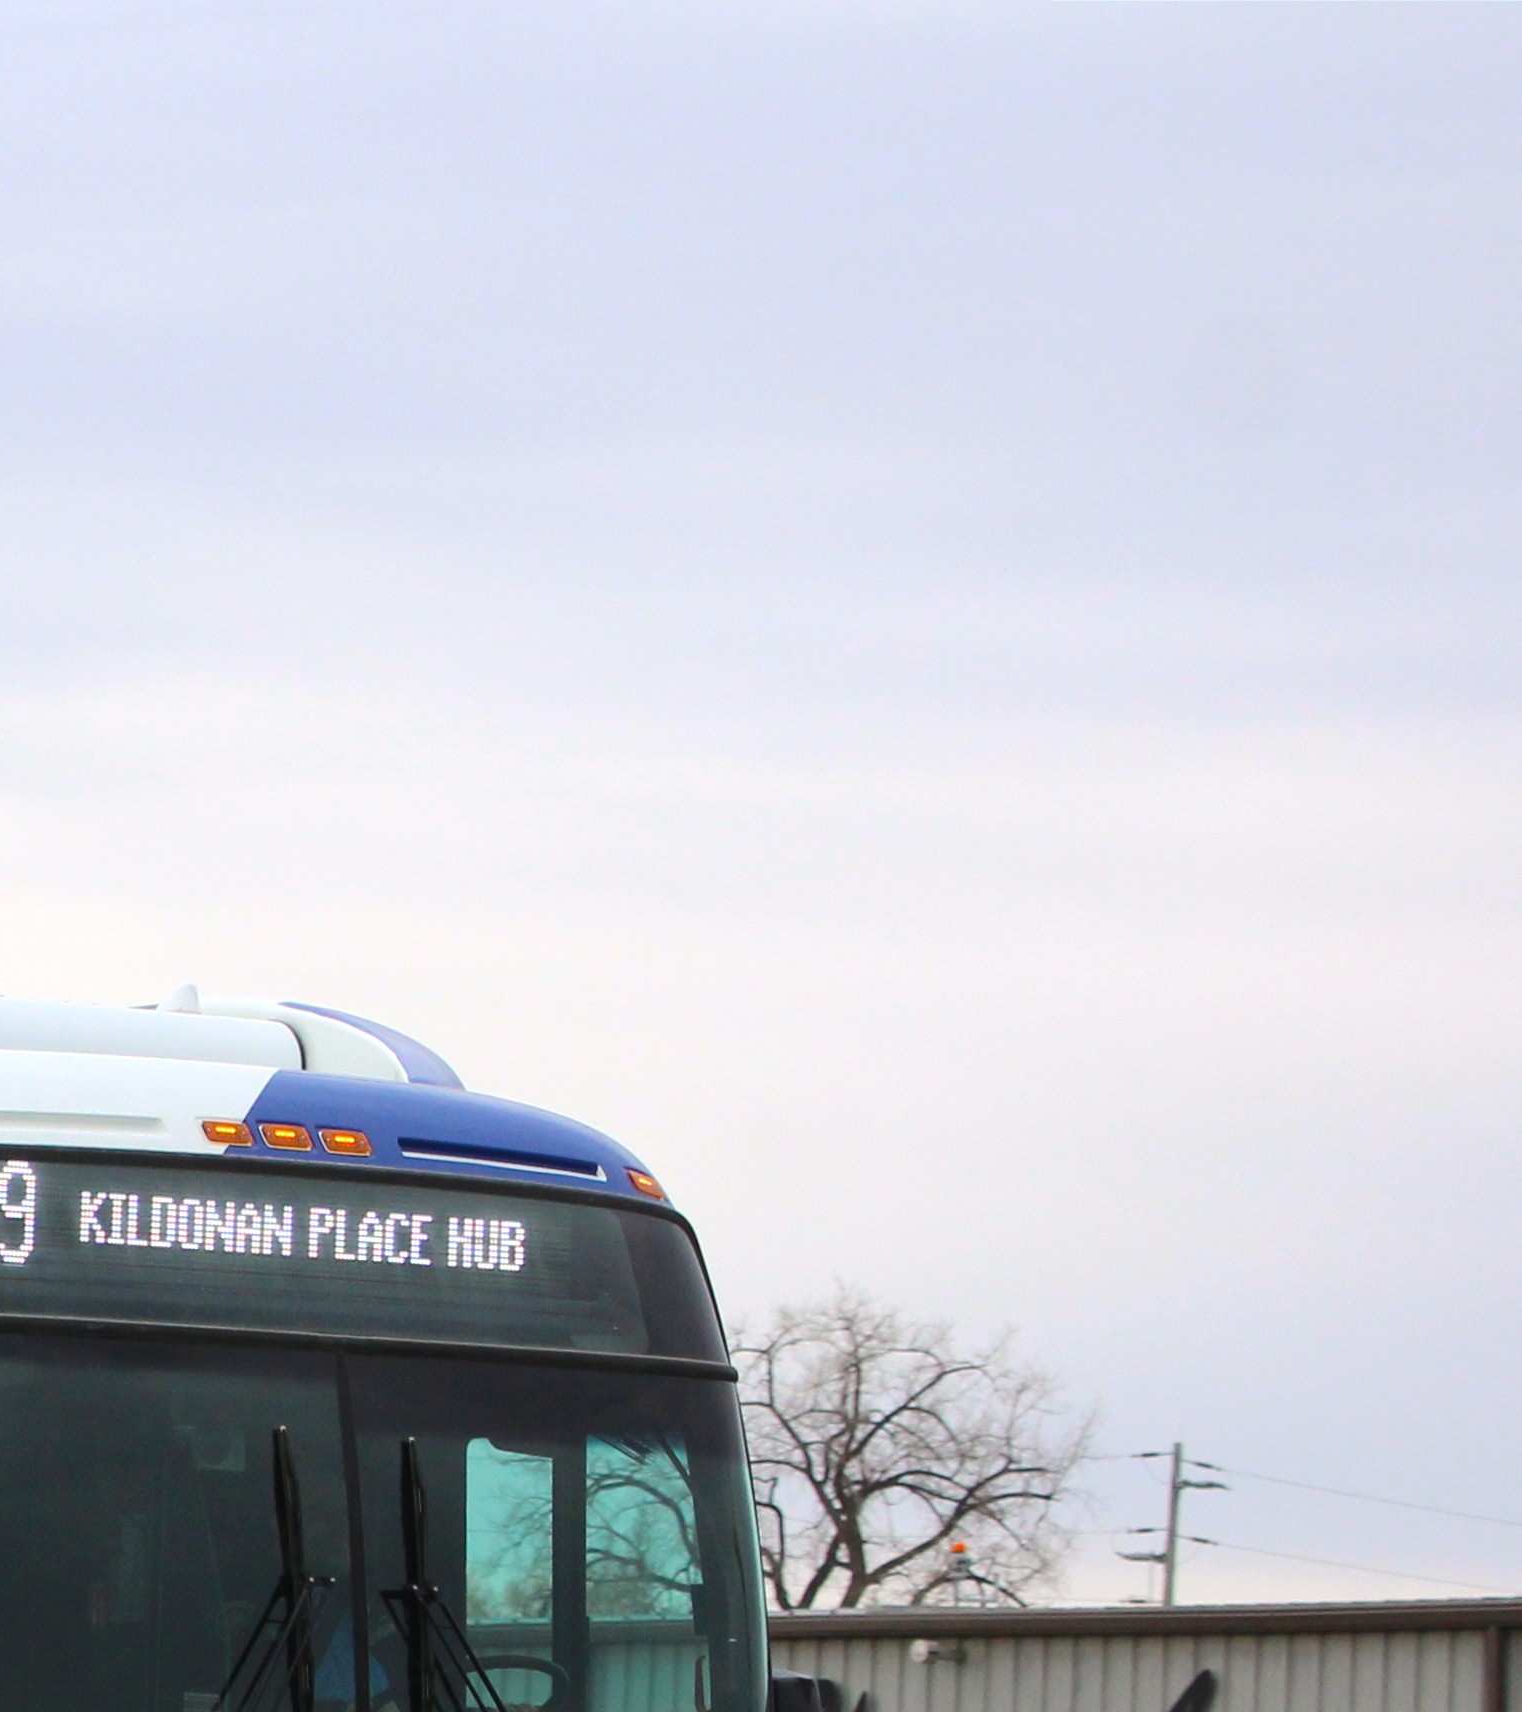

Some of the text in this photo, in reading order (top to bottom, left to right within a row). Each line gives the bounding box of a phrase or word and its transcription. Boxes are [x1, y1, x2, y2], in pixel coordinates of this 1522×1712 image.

[79, 1190, 293, 1257] KILDONAN
[308, 1206, 433, 1266] PLACE
[447, 1217, 526, 1271] HUB
